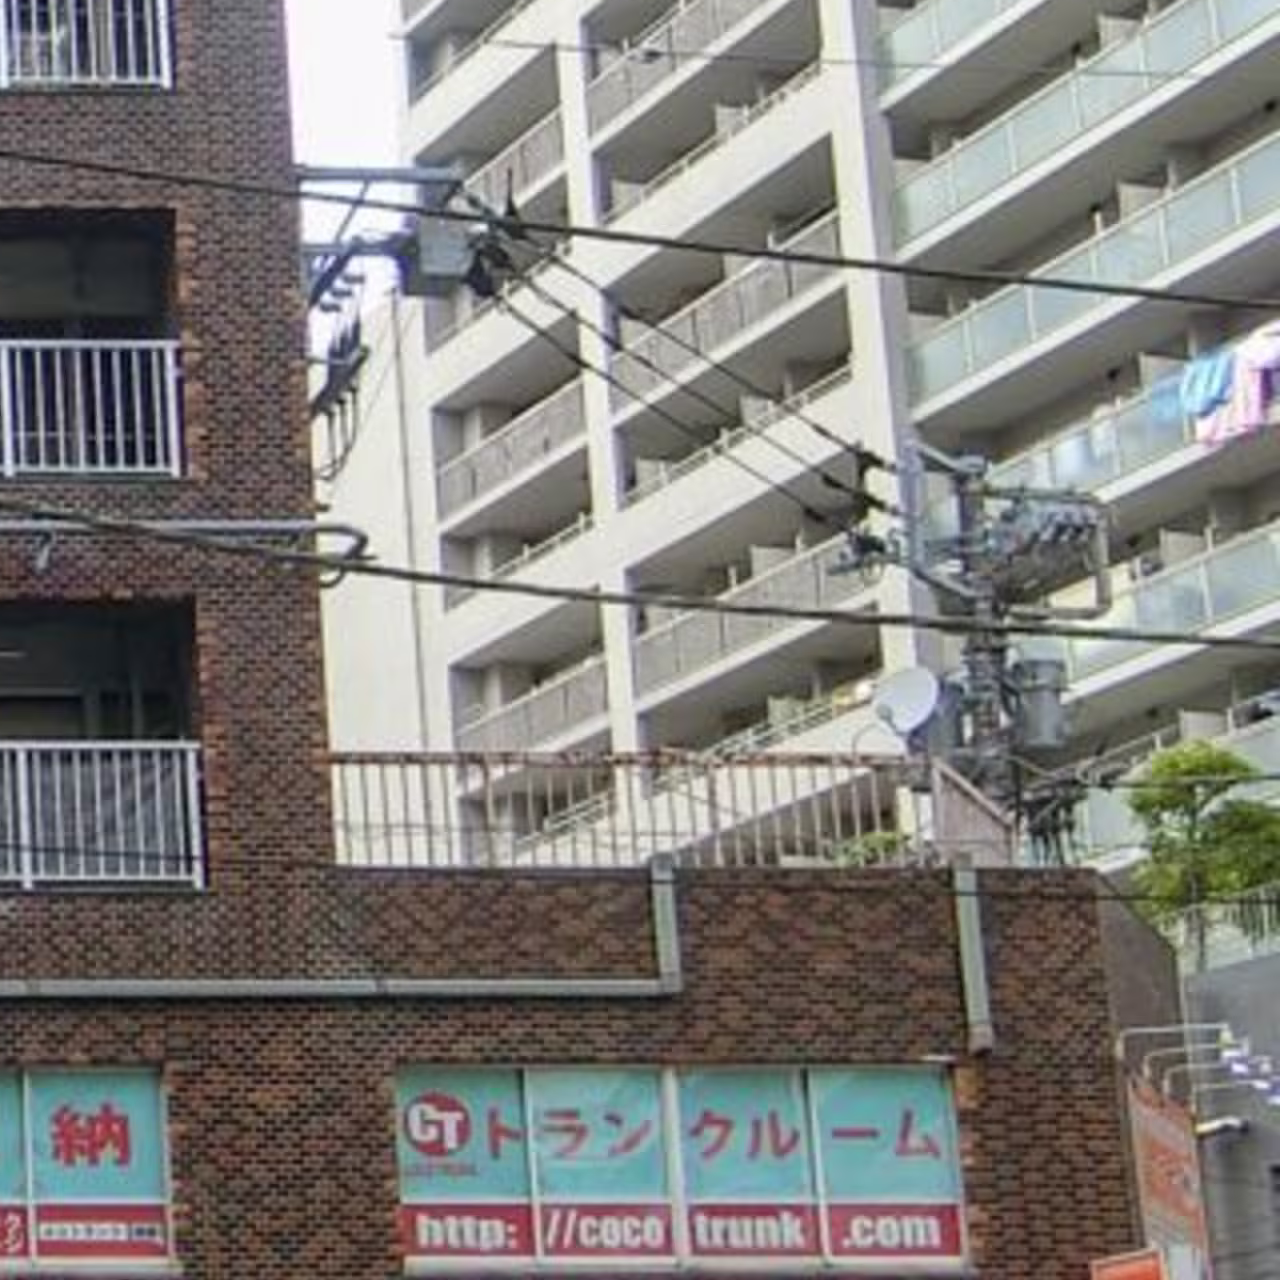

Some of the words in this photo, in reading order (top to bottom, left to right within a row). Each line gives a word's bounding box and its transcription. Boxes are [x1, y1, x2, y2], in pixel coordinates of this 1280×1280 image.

[486, 1108, 940, 1159] トランクルーム
